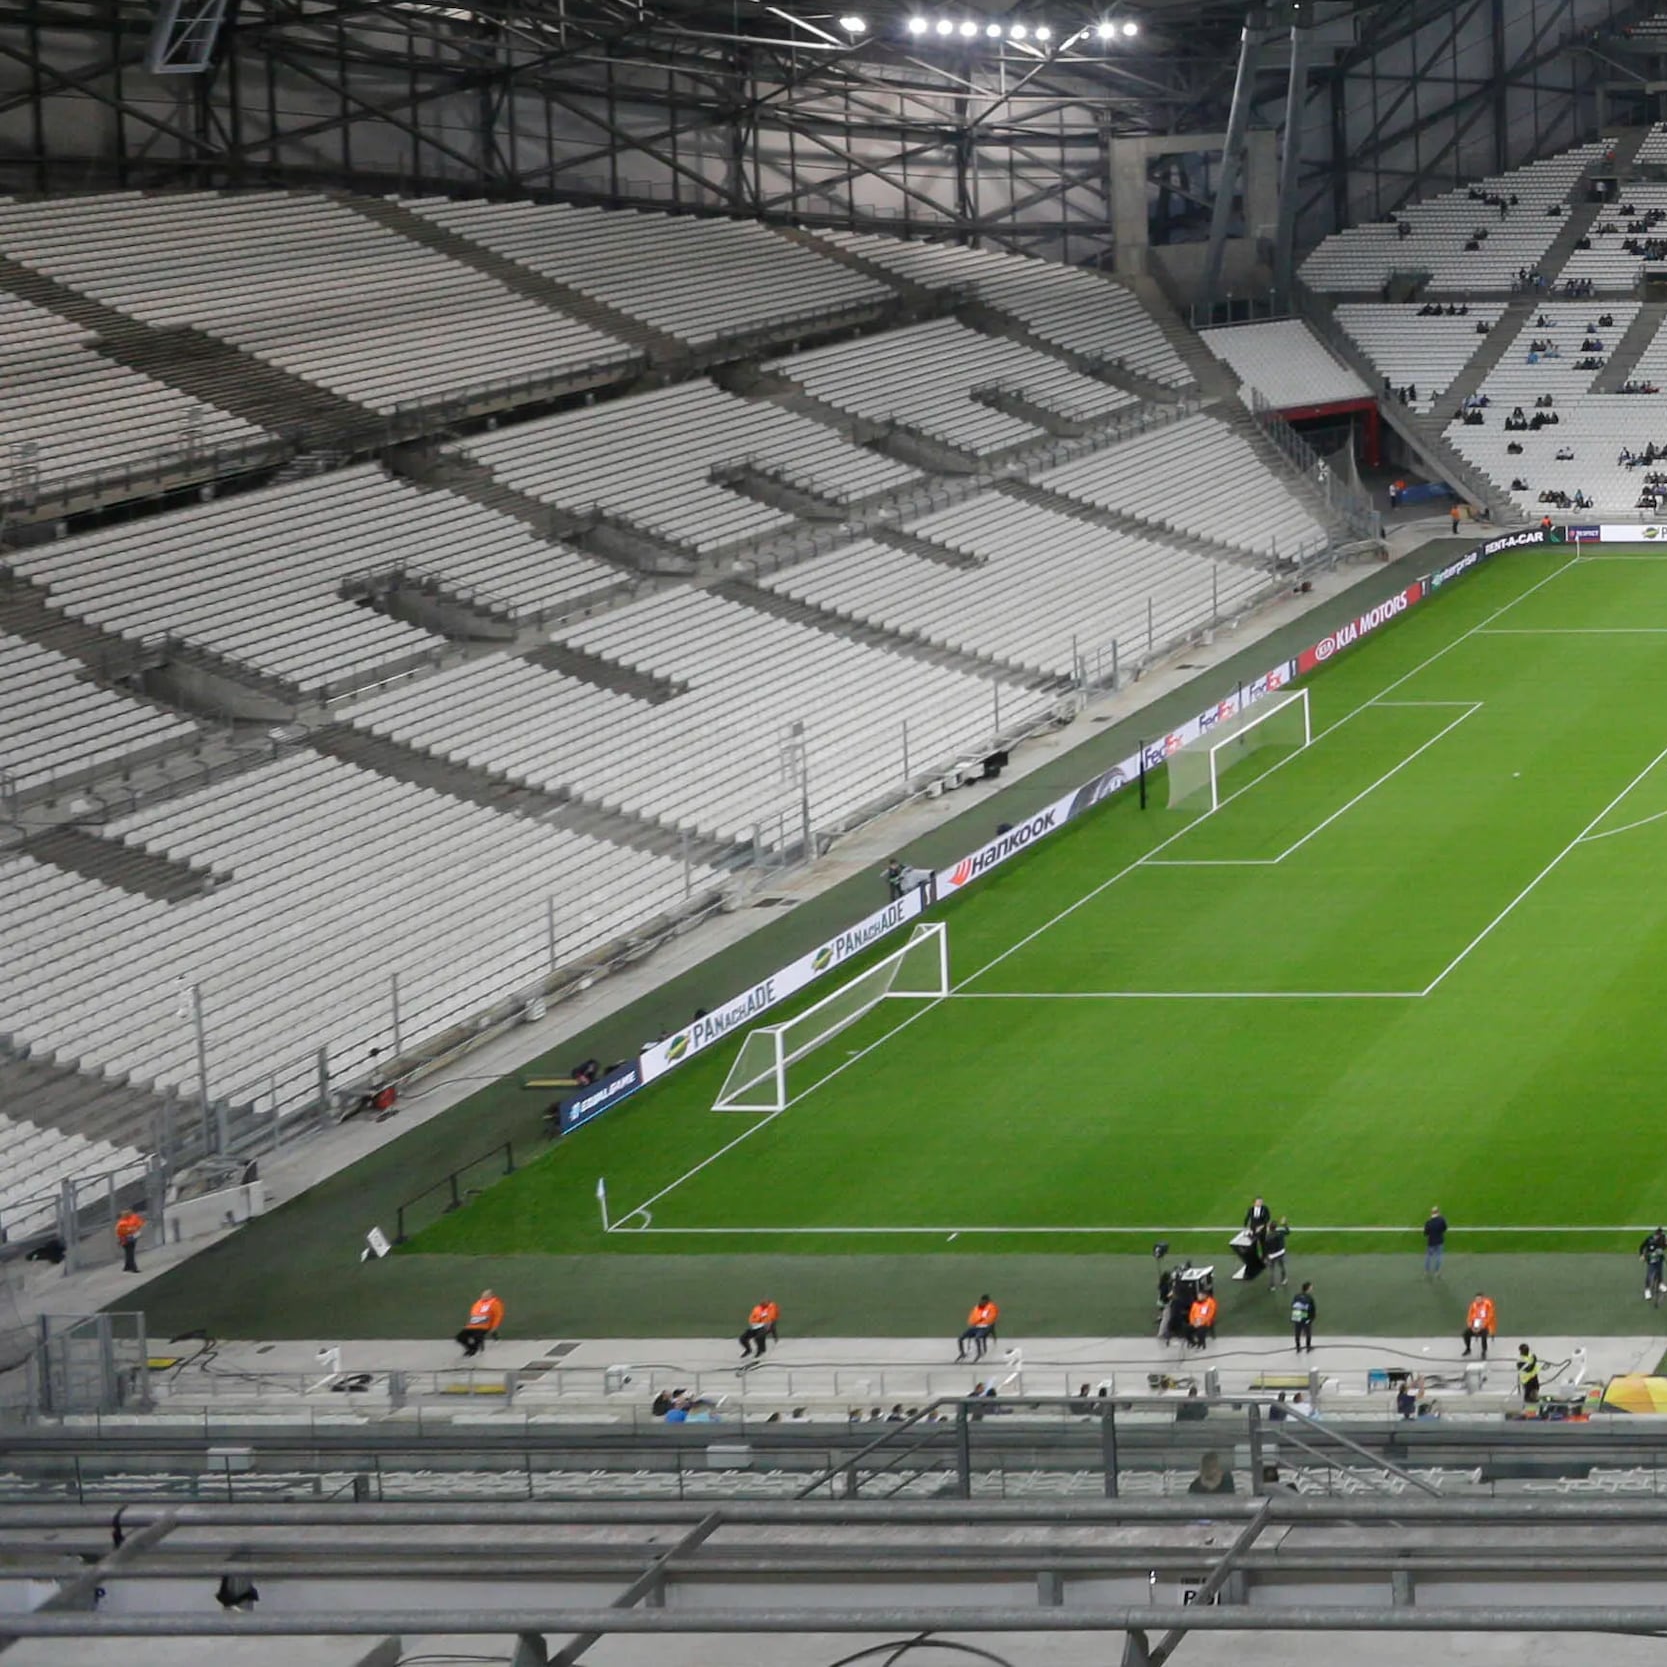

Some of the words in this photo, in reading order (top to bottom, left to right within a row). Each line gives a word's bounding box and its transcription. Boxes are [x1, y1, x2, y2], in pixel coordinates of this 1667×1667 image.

[1484, 531, 1544, 554] RENT-A-CAR
[1433, 551, 1477, 586] enterprise
[1317, 640, 1334, 658] KIA
[1336, 625, 1358, 650] KIA
[1359, 591, 1408, 636] MOTORS
[1144, 734, 1183, 770] FedEx
